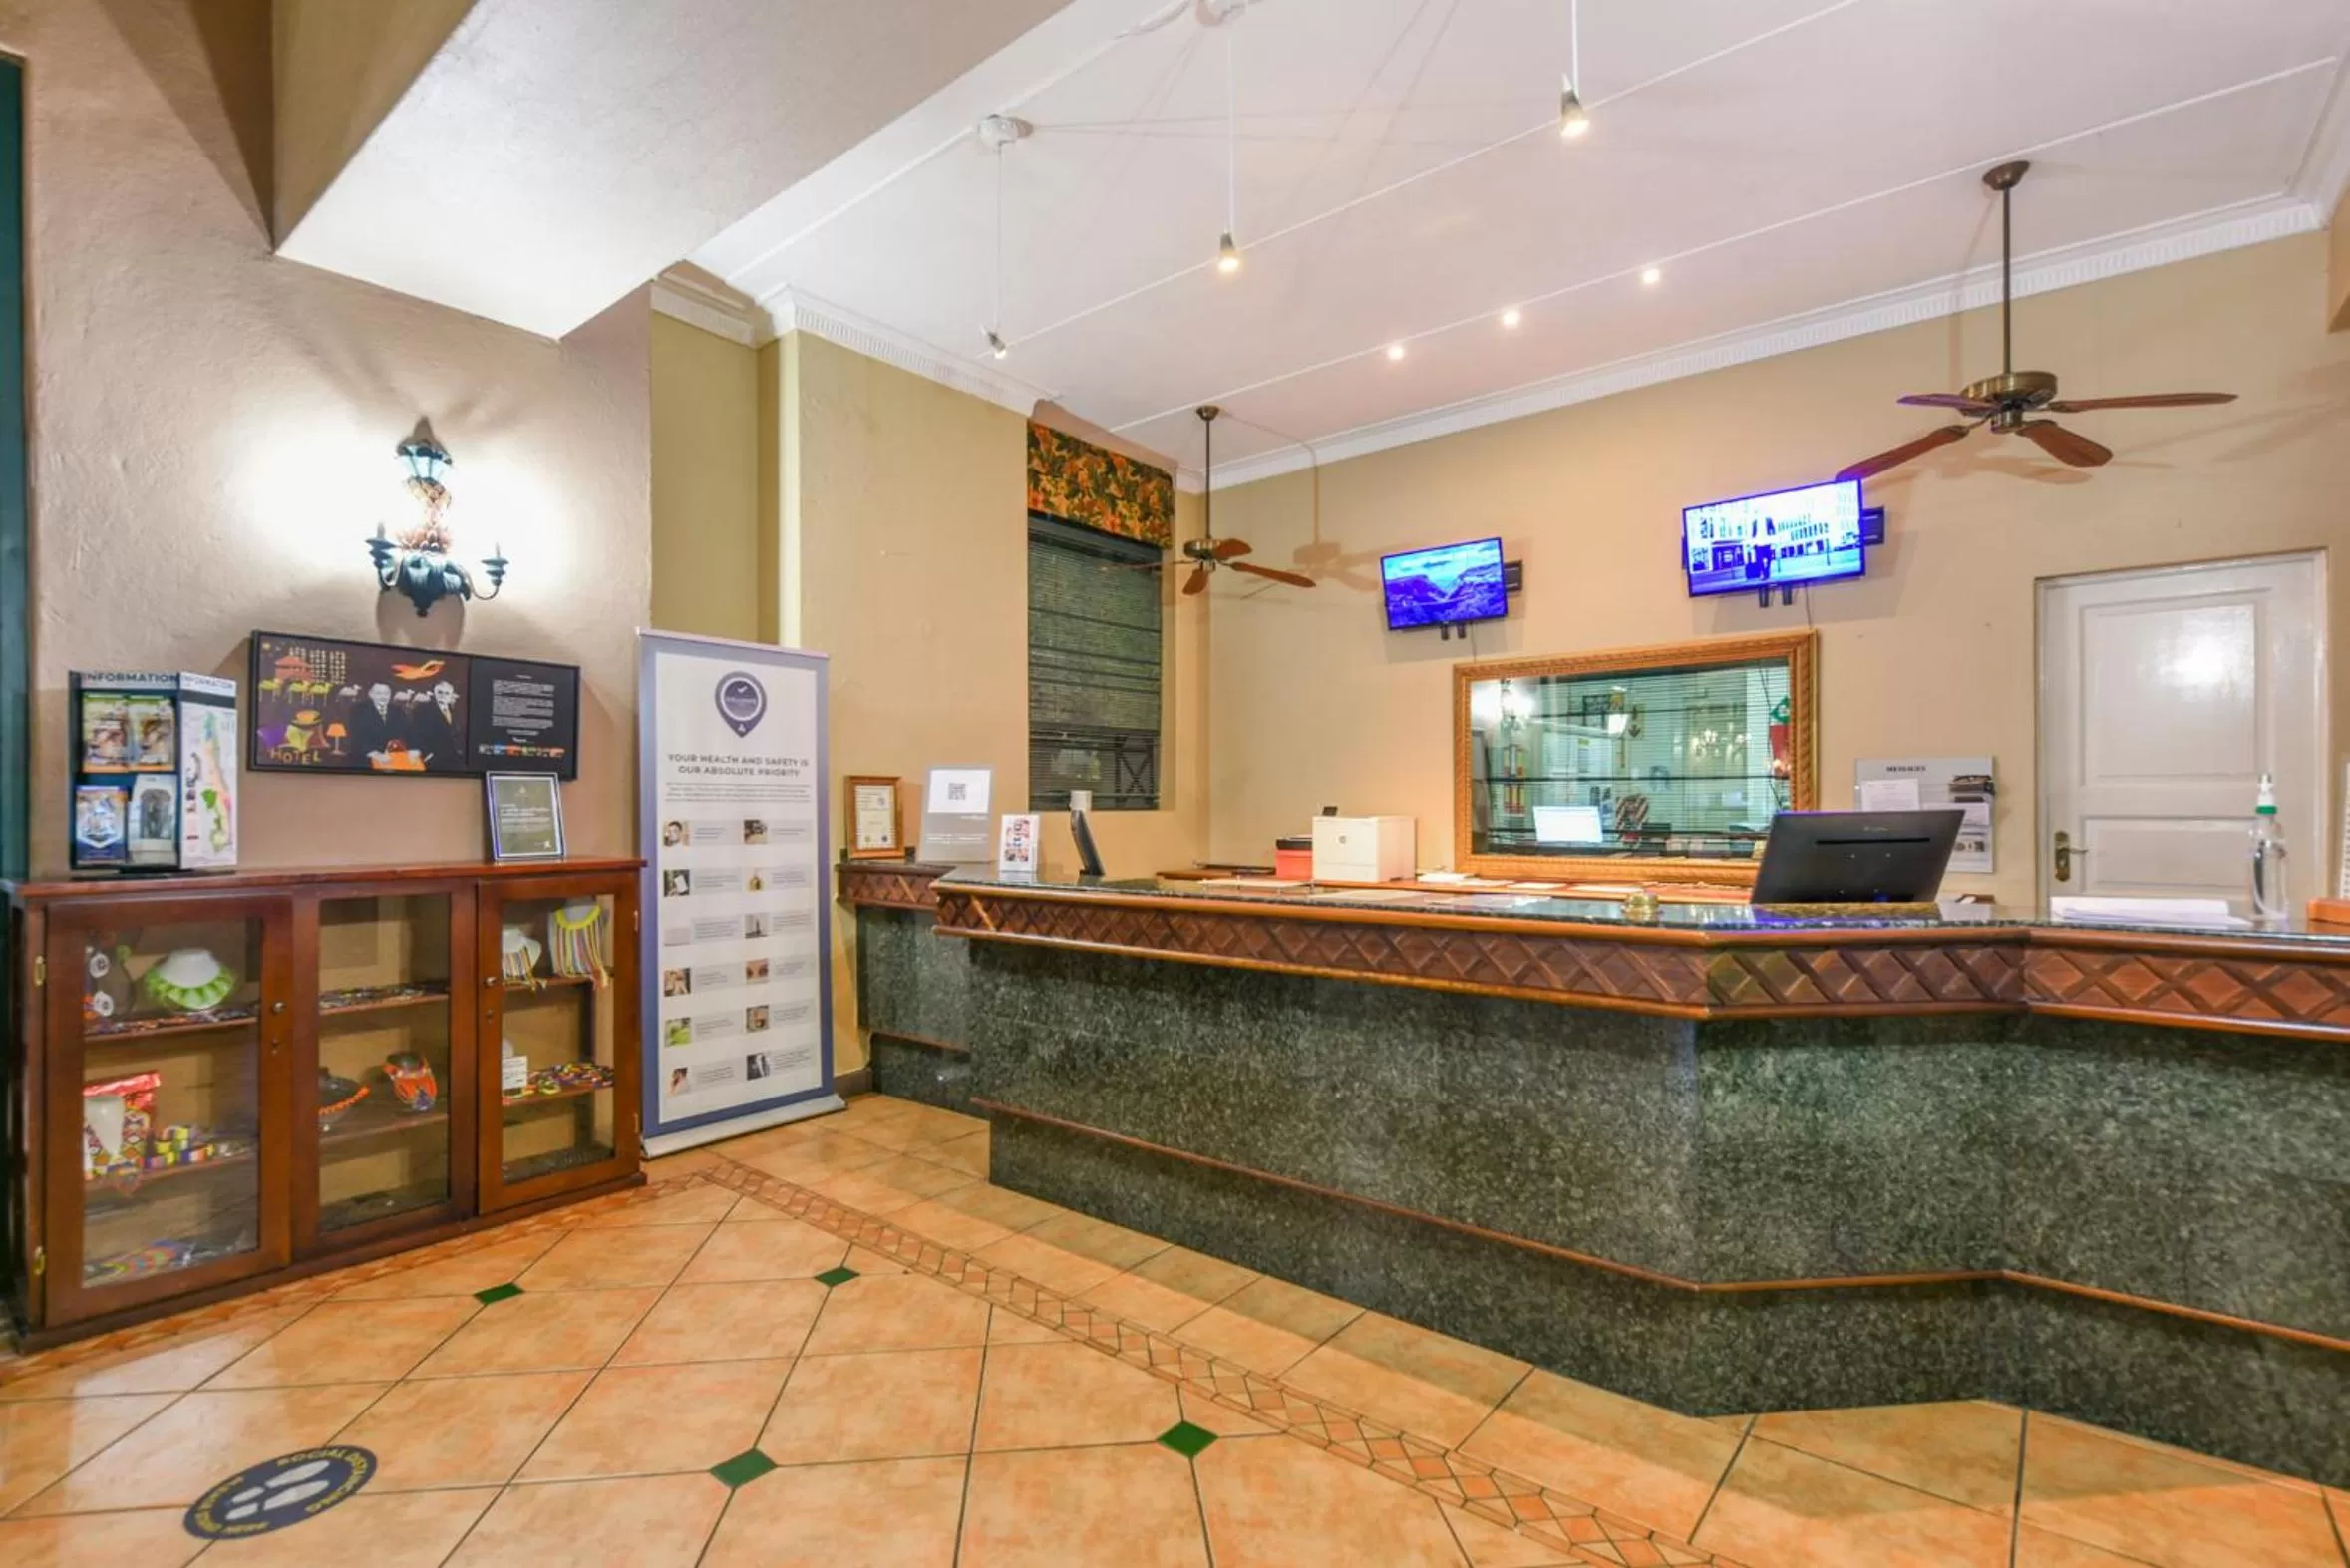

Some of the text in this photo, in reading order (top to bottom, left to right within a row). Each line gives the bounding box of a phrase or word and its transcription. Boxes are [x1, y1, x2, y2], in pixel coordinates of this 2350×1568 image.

[86, 673, 178, 683] NFORMATION
[269, 747, 323, 765] HOTEL
[667, 753, 697, 763] YOUR
[699, 754, 739, 765] HEALTH
[741, 756, 763, 766] AND
[765, 757, 799, 767] SAFETY
[678, 765, 801, 777] OUR ABSOLUTE PRIORITY
